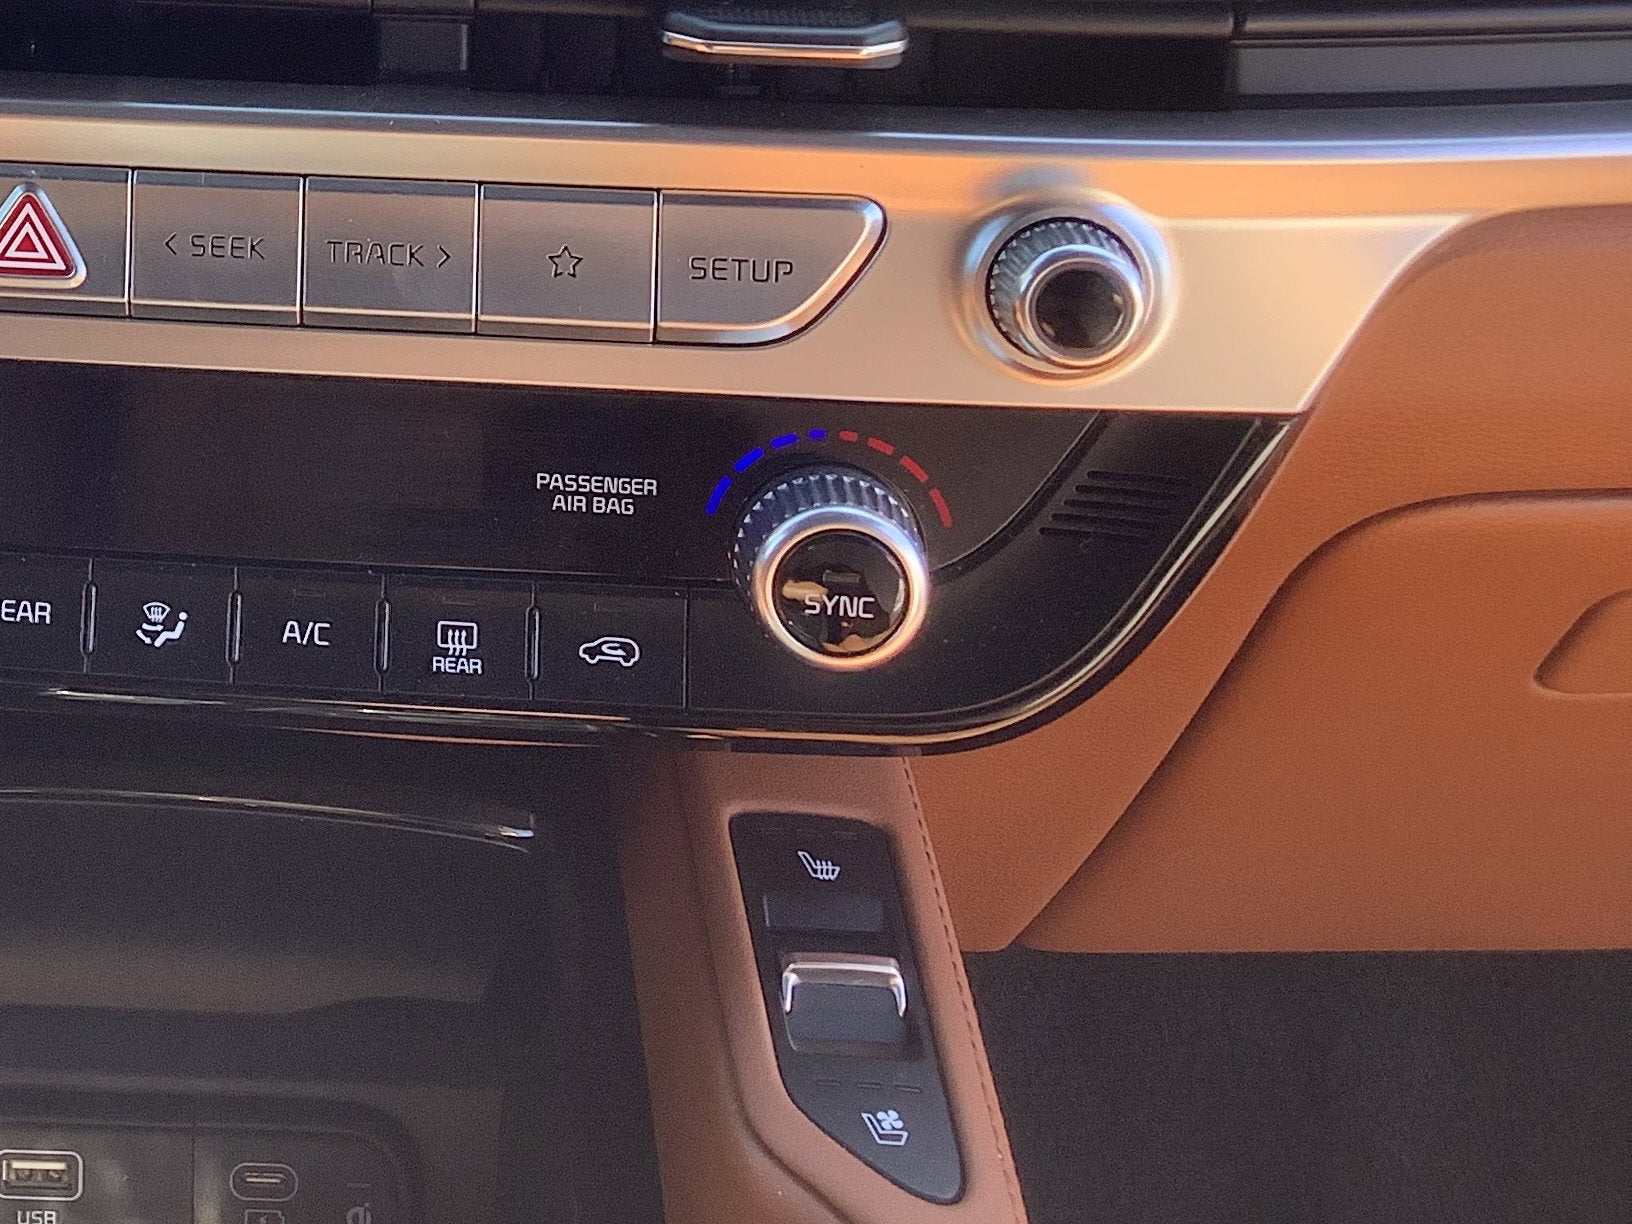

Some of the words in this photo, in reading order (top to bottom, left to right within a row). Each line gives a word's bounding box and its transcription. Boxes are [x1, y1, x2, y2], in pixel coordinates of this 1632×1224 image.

[190, 234, 266, 260] SEEK
[326, 239, 425, 268] TRACK
[689, 255, 794, 284] SETUP
[536, 472, 658, 497] PASSENGER
[551, 493, 587, 513] AIR
[592, 495, 634, 515] BAG
[804, 594, 875, 619] SYNC
[282, 621, 331, 646] A/C
[432, 656, 483, 675] REAR
[17, 1210, 58, 1224] USB
